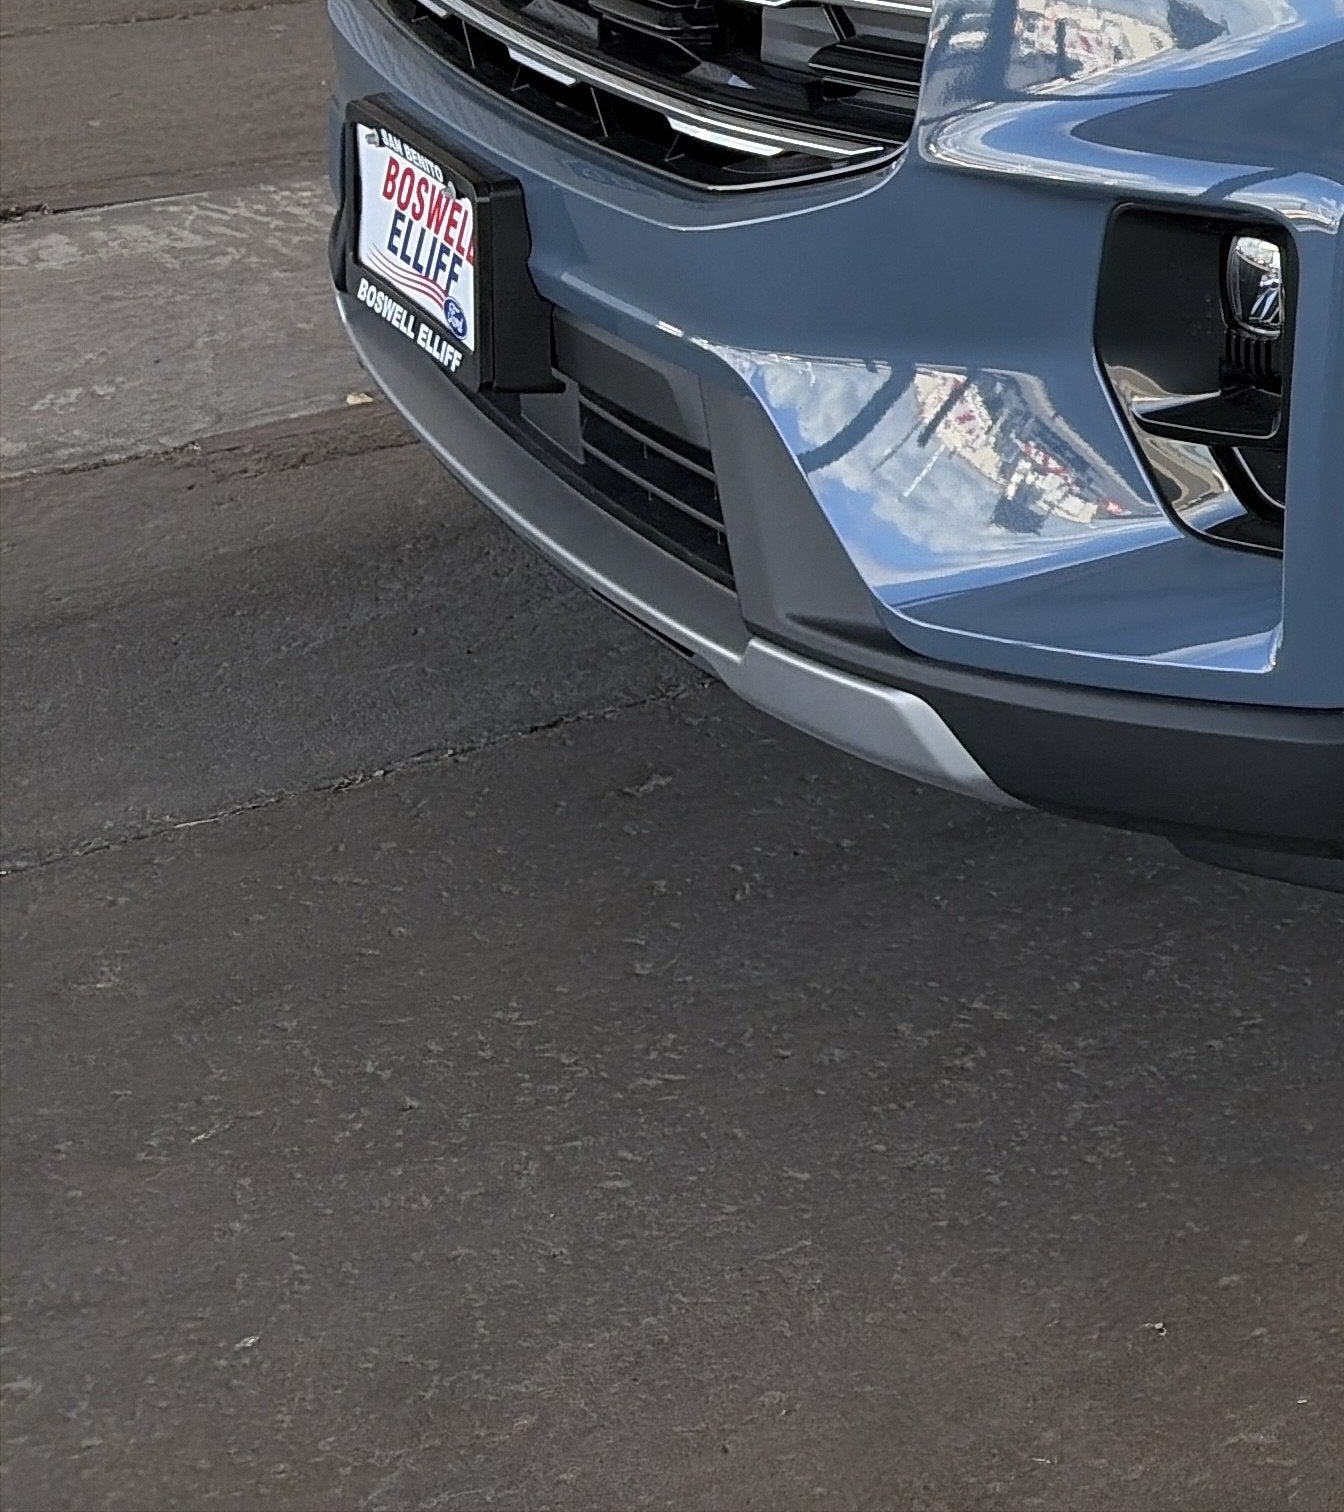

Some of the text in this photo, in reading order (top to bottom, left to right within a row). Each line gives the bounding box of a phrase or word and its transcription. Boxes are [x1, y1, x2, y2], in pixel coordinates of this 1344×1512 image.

[380, 127, 444, 183] SAN BENITO
[387, 209, 463, 296] ELLIFF
[356, 277, 463, 373] BOSWELL ELLIFF
[447, 301, 464, 335] Ford
